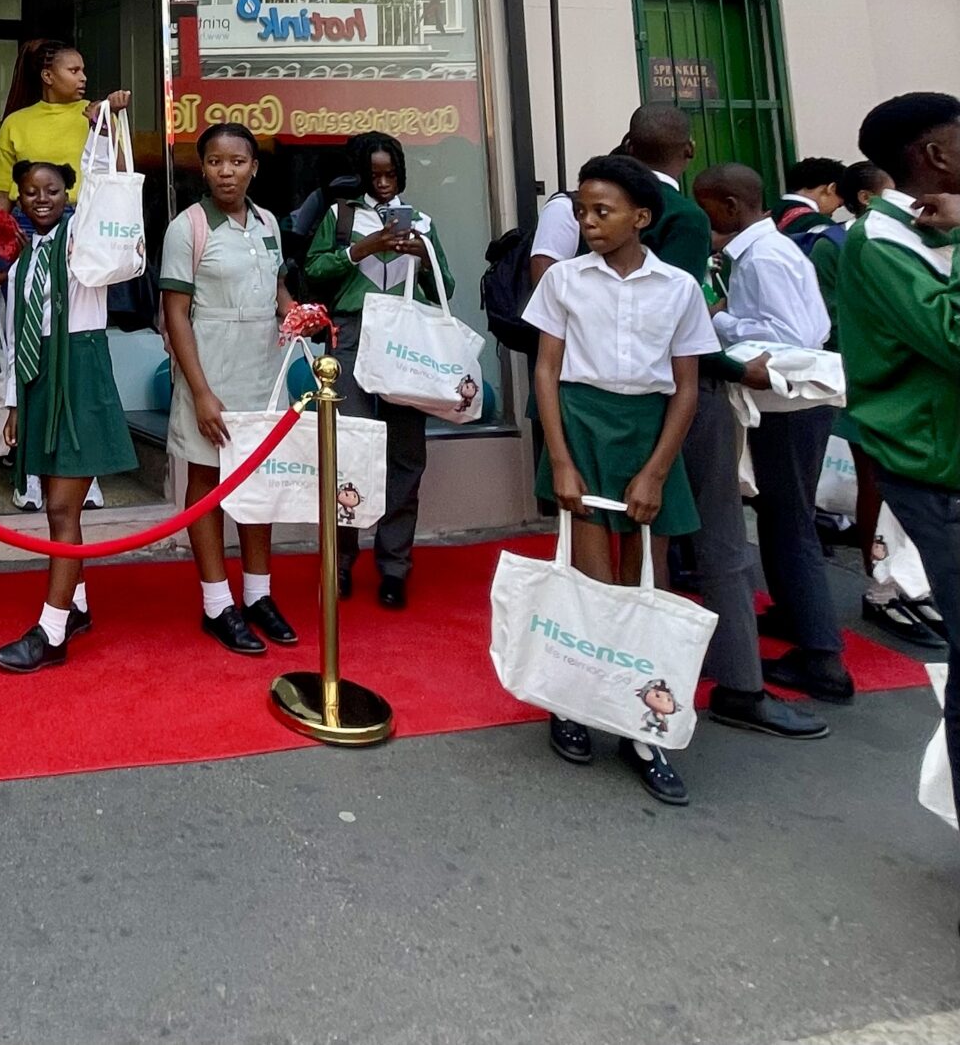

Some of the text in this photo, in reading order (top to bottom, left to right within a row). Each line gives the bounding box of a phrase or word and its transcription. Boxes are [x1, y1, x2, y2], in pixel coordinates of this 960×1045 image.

[653, 64, 707, 75] SPRNKLR
[680, 76, 711, 87] VALE
[385, 340, 464, 375] Hisense
[529, 614, 655, 676] Hisense
